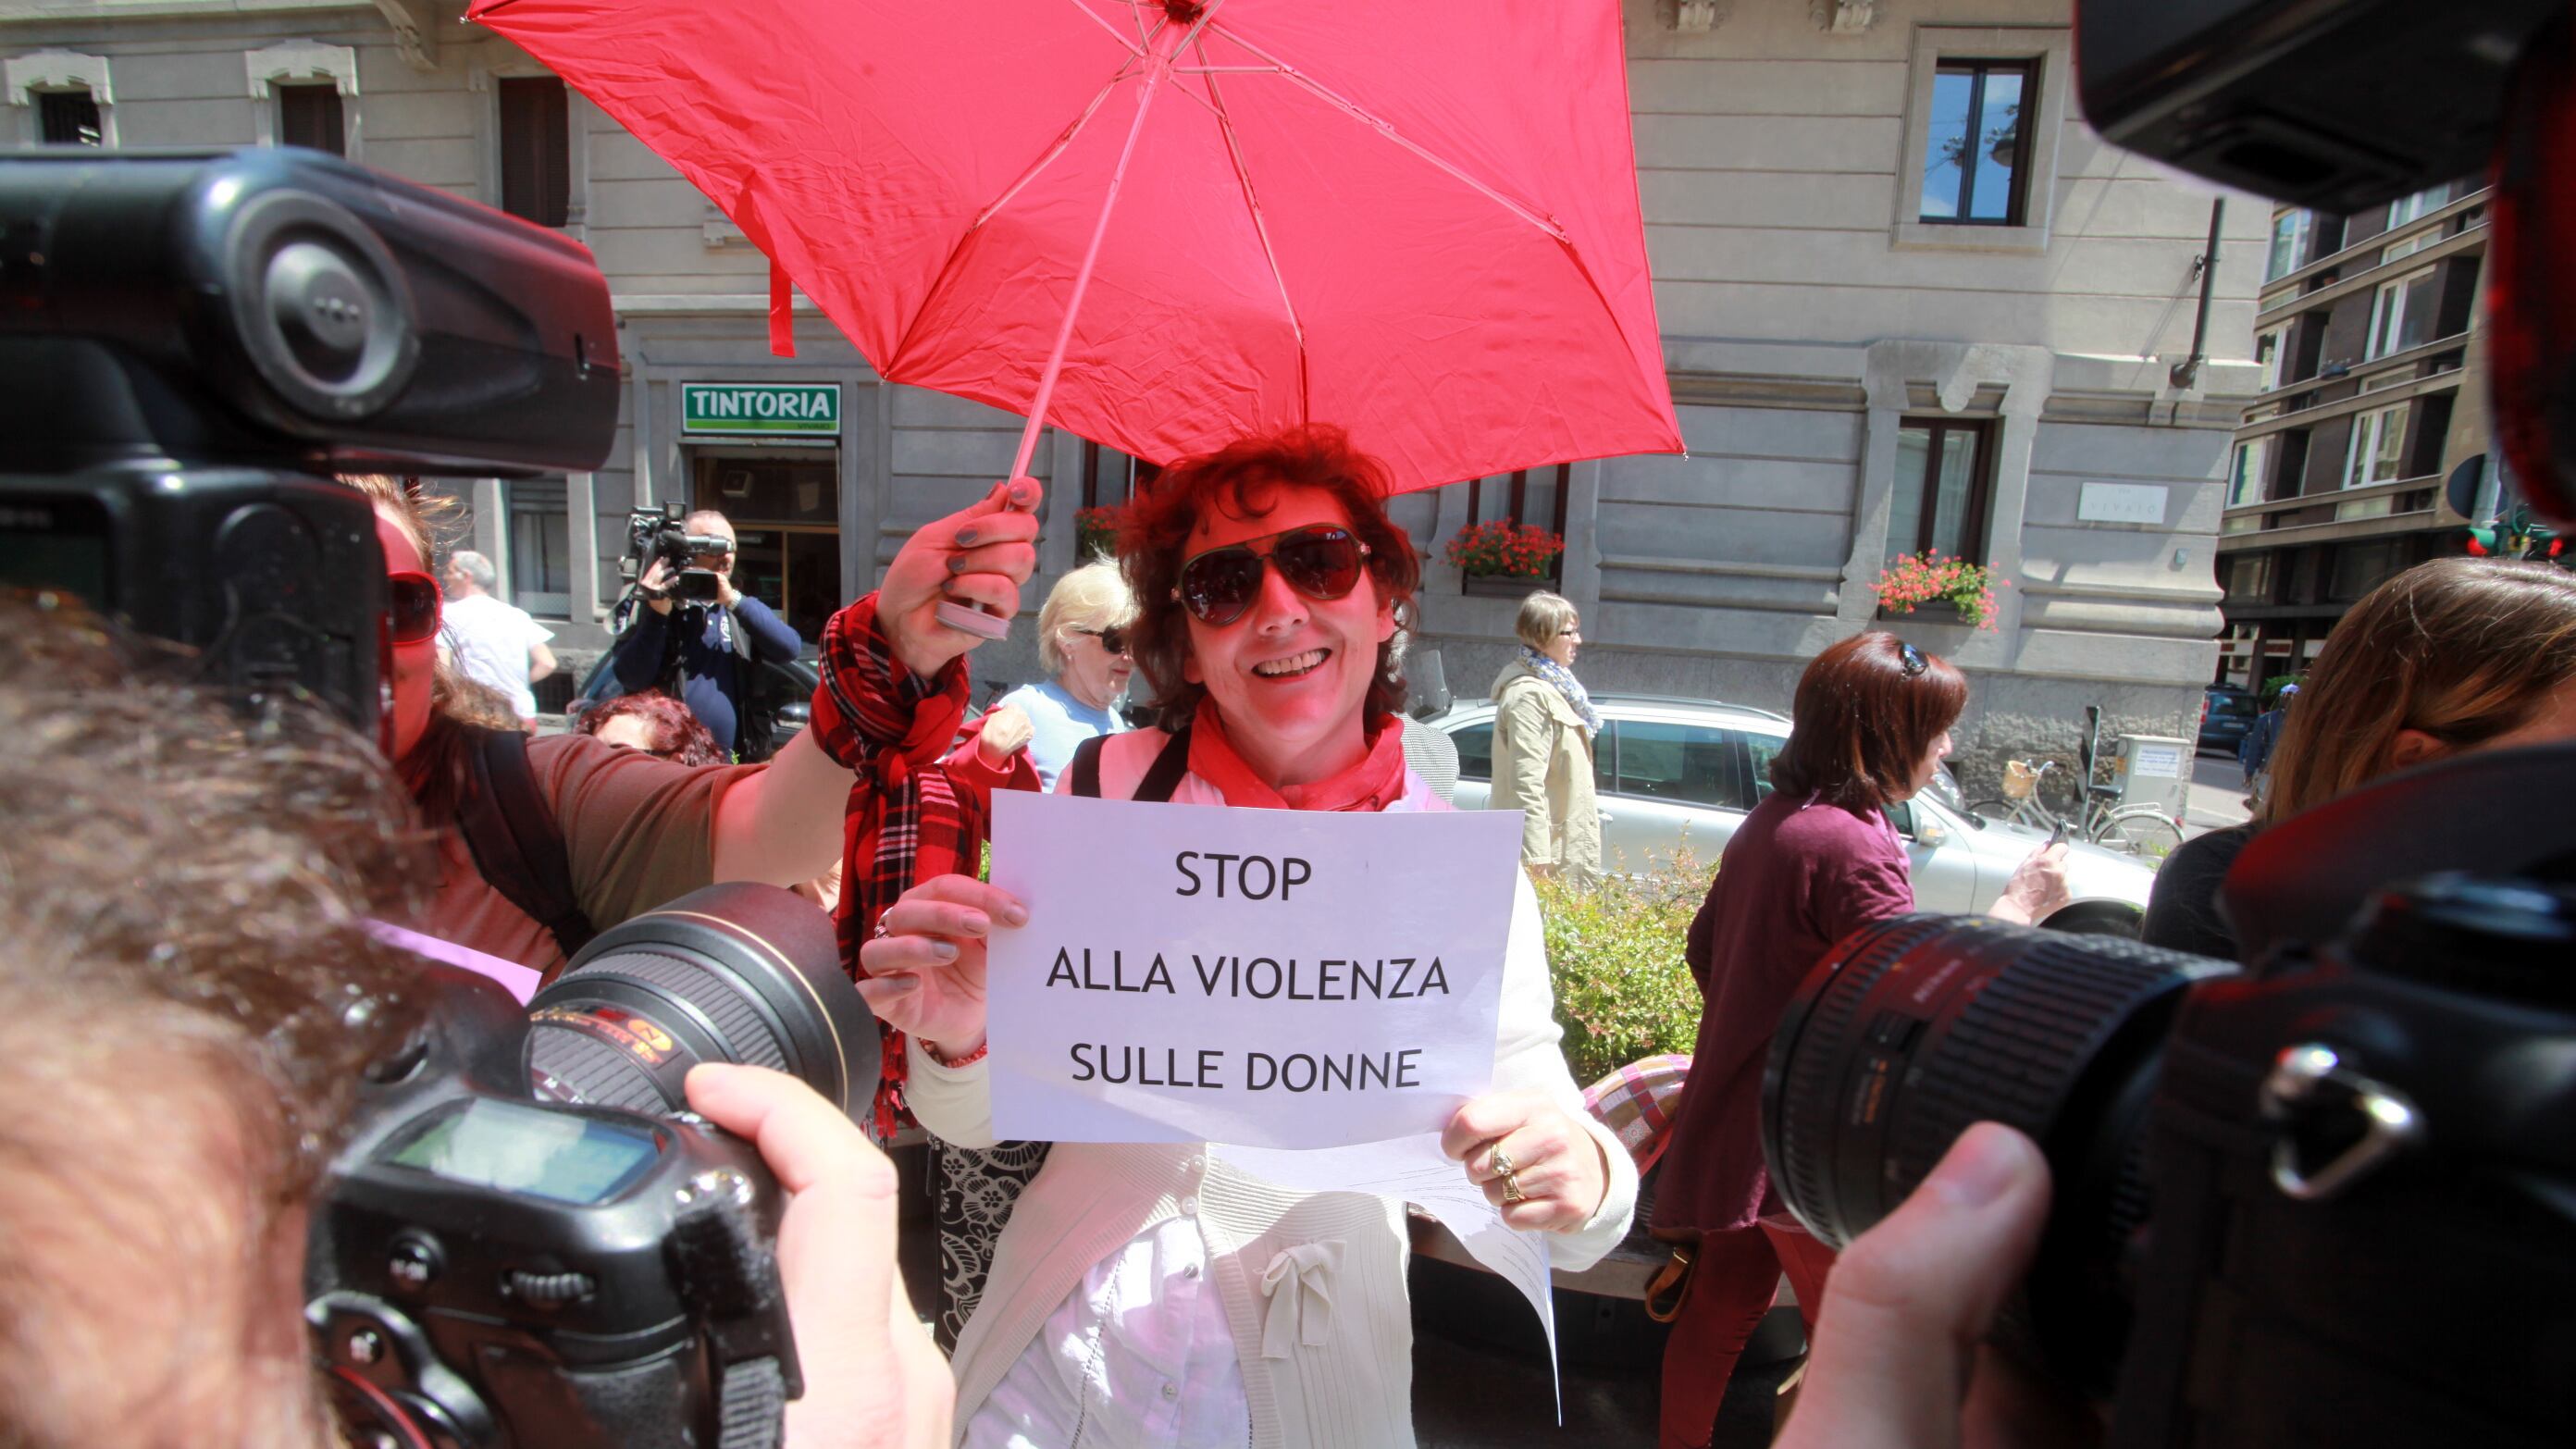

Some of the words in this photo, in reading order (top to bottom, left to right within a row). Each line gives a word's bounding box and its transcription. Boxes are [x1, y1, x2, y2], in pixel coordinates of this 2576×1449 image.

[691, 390, 831, 418] TINTORIA
[1175, 850, 1312, 901] STOP
[1046, 946, 1176, 995] ALLA
[1192, 954, 1450, 1000] VIOLENZA
[1070, 1043, 1224, 1089] SULLE
[1246, 1048, 1422, 1093] DONNE
